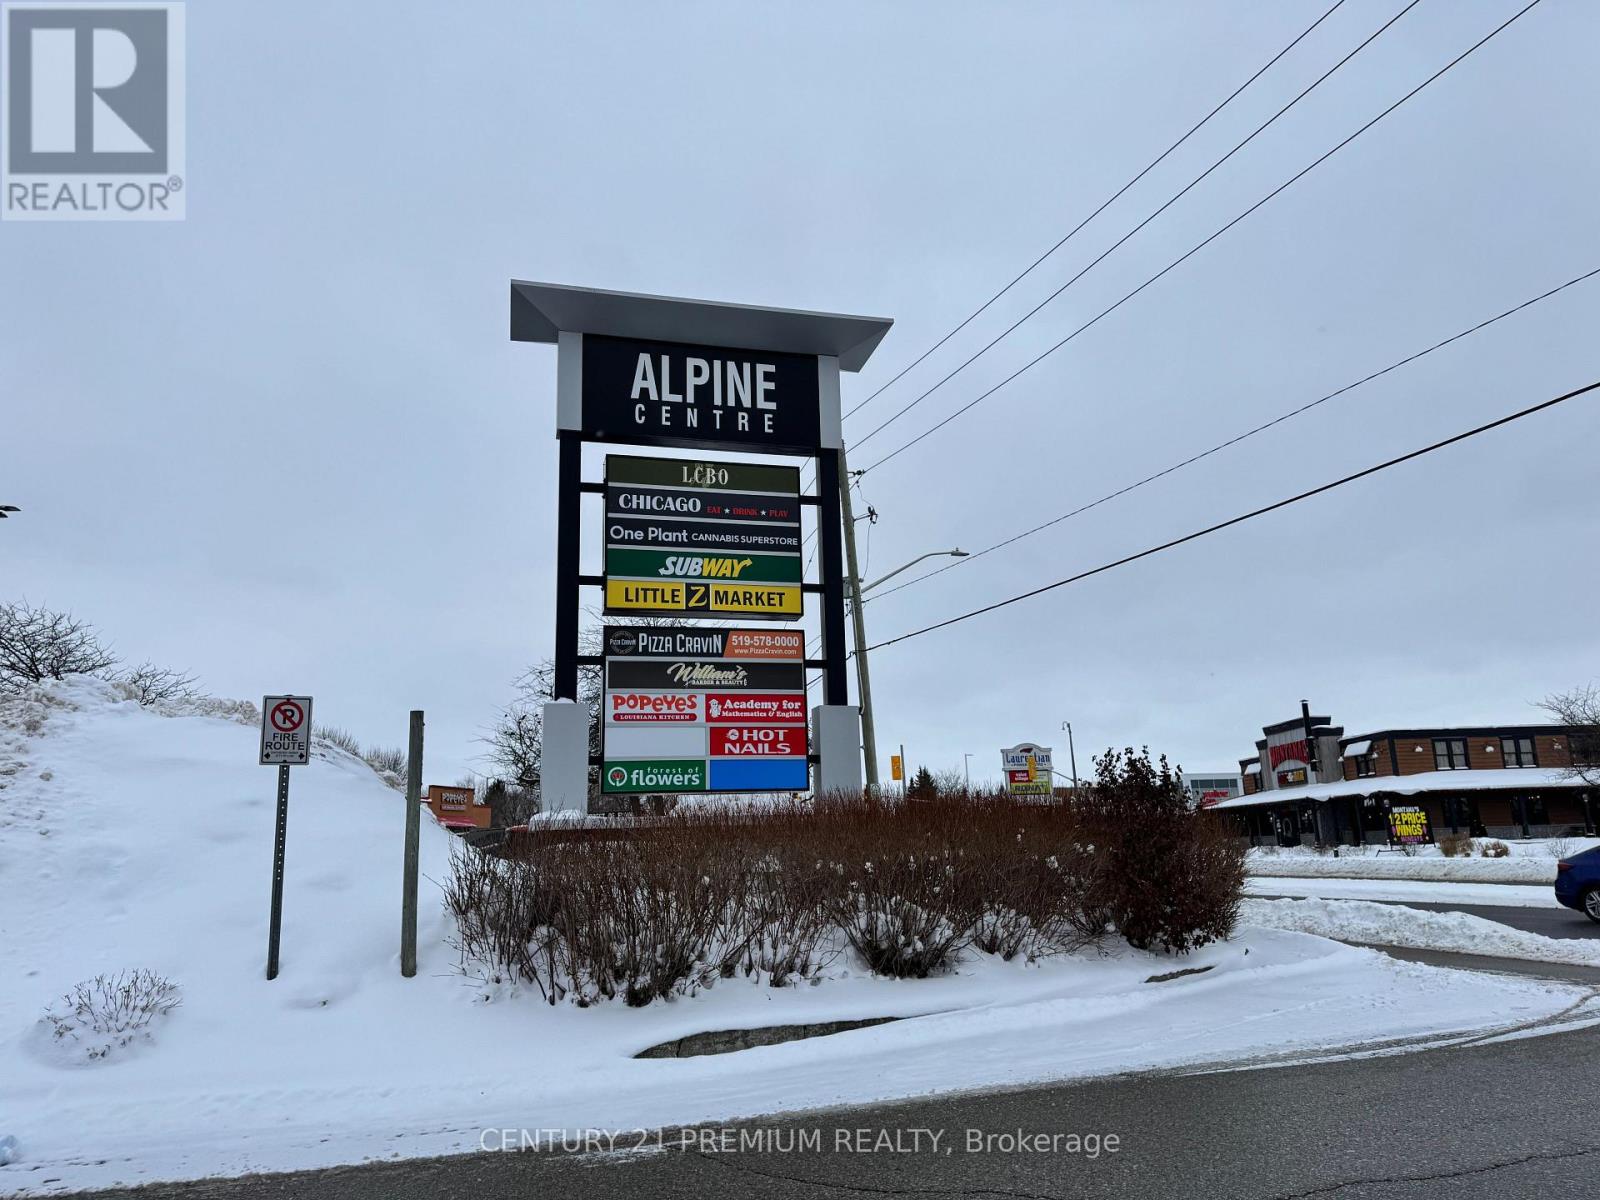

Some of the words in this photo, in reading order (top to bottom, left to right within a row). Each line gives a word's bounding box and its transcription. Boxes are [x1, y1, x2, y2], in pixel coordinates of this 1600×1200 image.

[630, 352, 777, 410] ALPINE
[634, 403, 774, 433] CENTRE
[682, 466, 729, 485] LCBO
[618, 493, 701, 513] CHICAGO
[706, 506, 721, 515] EAT
[732, 507, 758, 517] DRINK
[768, 509, 789, 518] PLAY
[610, 525, 644, 541] One
[647, 527, 689, 542] Plant
[691, 532, 740, 543] CANNABIS
[741, 535, 799, 546] SUPERSTORE
[658, 556, 753, 578] SUBWAY
[624, 586, 681, 604] LITTLE
[687, 586, 708, 608] Z
[714, 589, 786, 607] MARKET
[676, 633, 723, 654] CRAVIN
[731, 635, 800, 647] 519-578-0000
[734, 647, 797, 656] www.PizzaCravin.com
[666, 662, 748, 682] William's
[723, 699, 778, 711] Academy
[782, 699, 802, 709] for
[721, 710, 767, 718] Mathematics
[776, 711, 803, 719] English
[272, 732, 299, 742] FIRE
[742, 729, 788, 741] HOT
[265, 741, 305, 751] ROUTE
[724, 743, 791, 754] NAILS
[647, 766, 682, 774] forest
[688, 766, 699, 774] of
[630, 768, 700, 787] flowers
[1401, 811, 1428, 824] PRICE
[1395, 824, 1423, 837] WINGS
